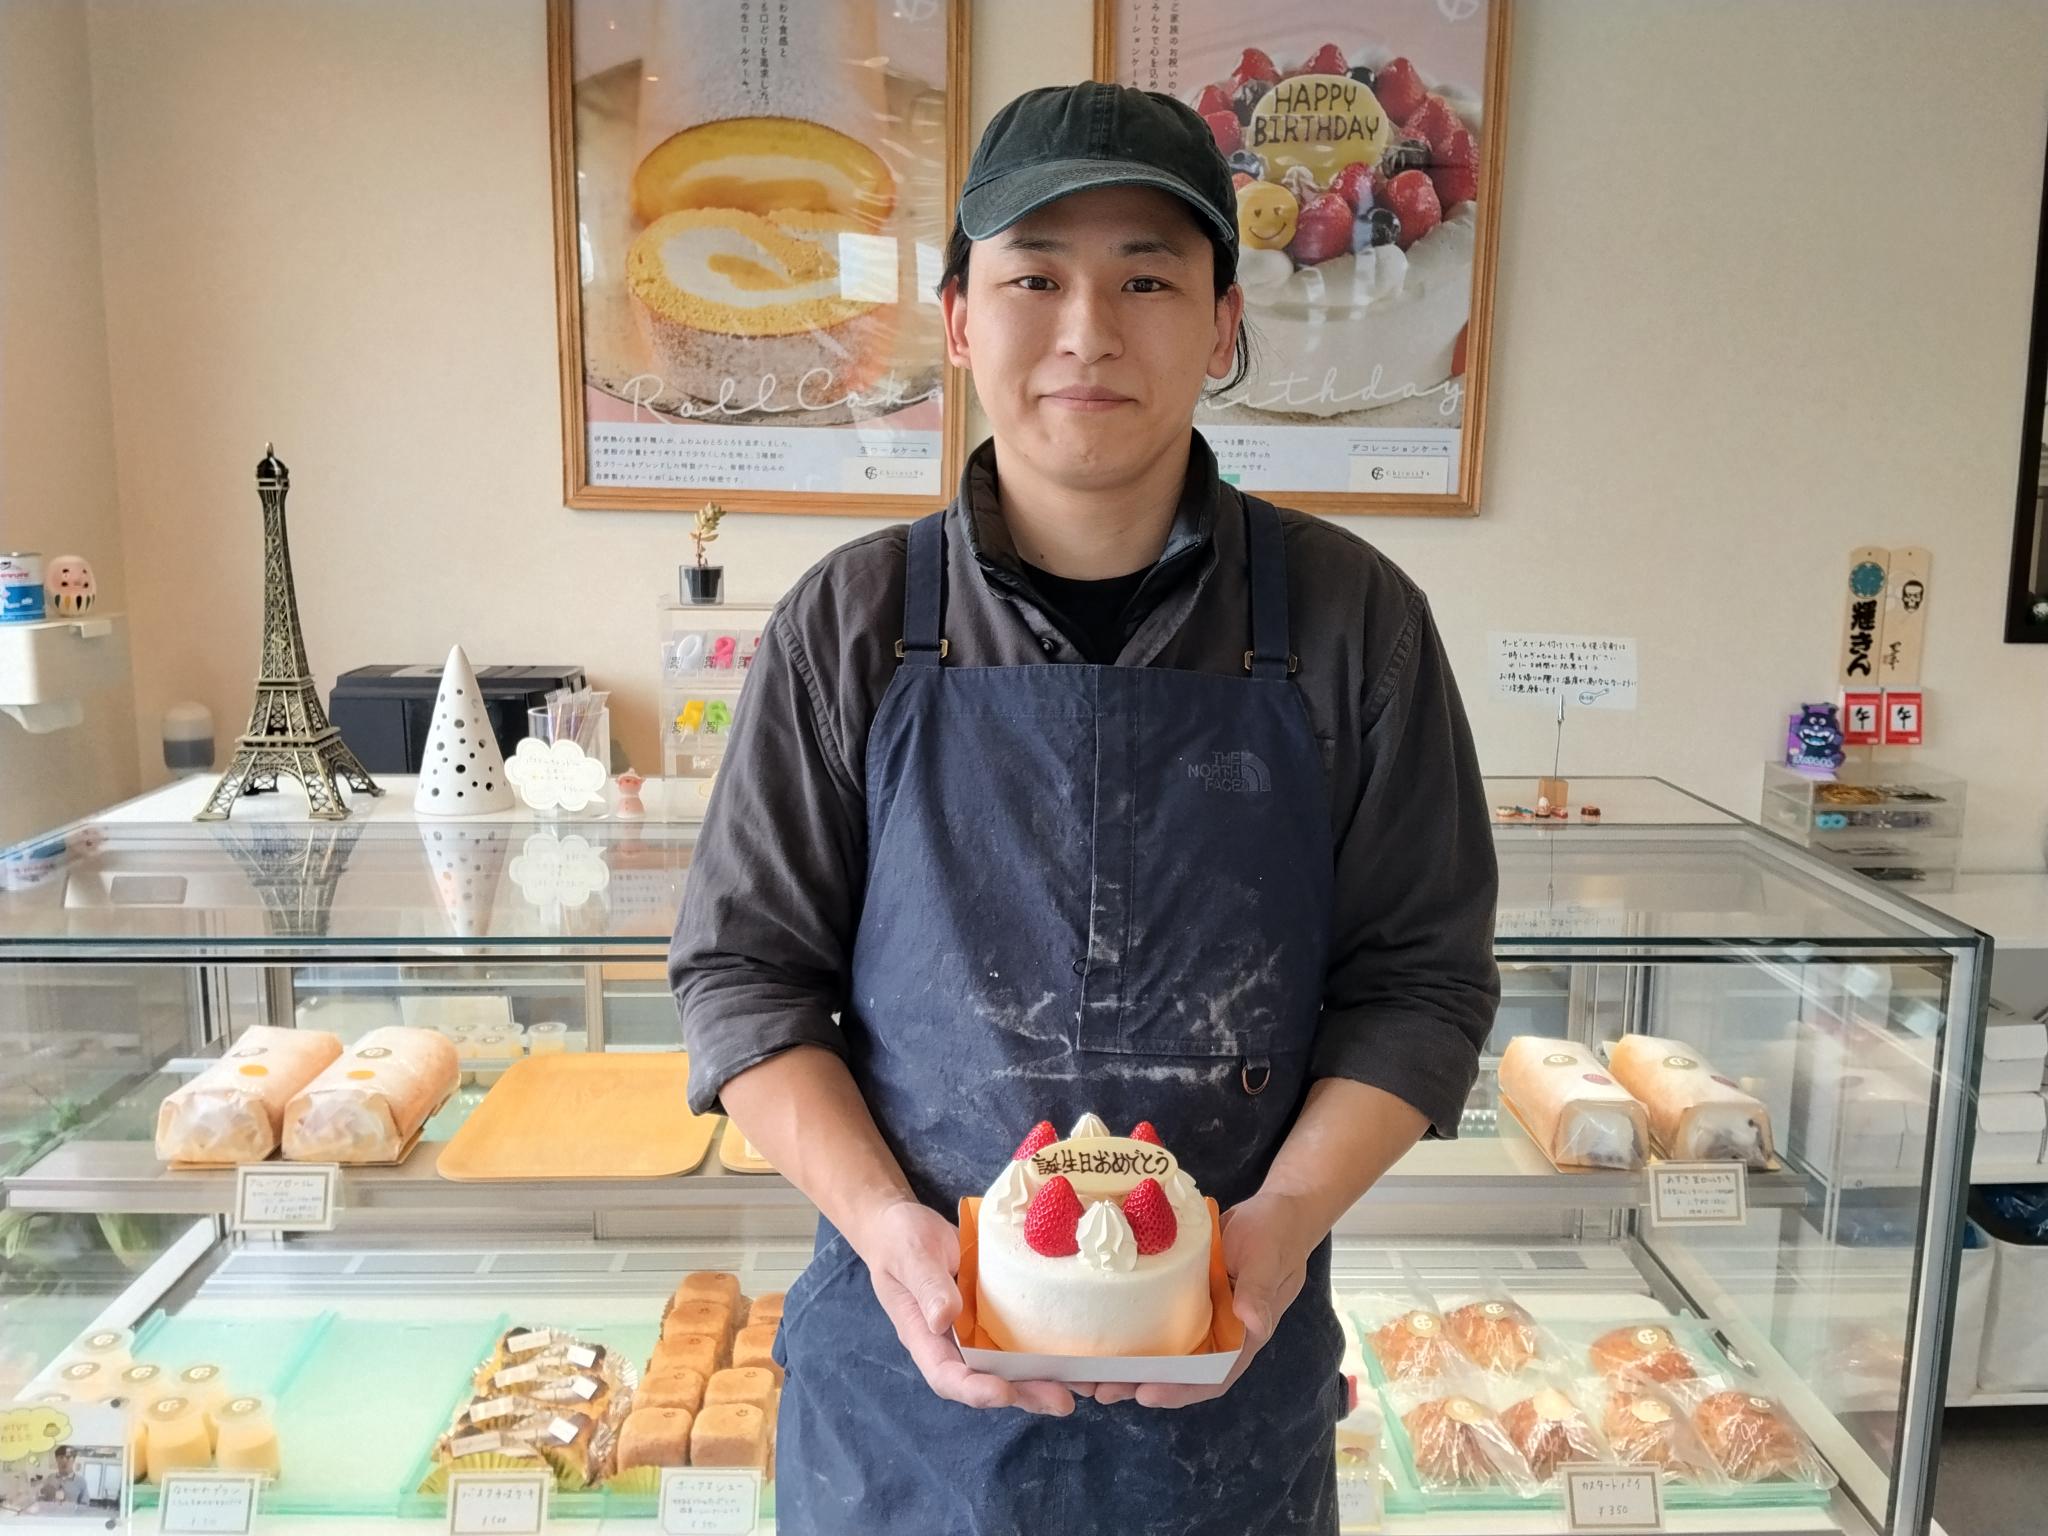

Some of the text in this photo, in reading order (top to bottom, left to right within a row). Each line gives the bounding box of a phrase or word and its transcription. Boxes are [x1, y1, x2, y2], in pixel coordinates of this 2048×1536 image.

[1274, 83, 1357, 113] HAPPY
[1253, 113, 1380, 147] BIRTHDAY
[1351, 443, 1449, 454] デコレーションケーキ
[1855, 706, 1870, 730] 午
[1897, 706, 1912, 730] 午
[1212, 751, 1241, 765] THE
[1187, 763, 1241, 779] NORTH
[1204, 777, 1241, 792] FACE
[1032, 1149, 1169, 1176] 誕生日おめでとう
